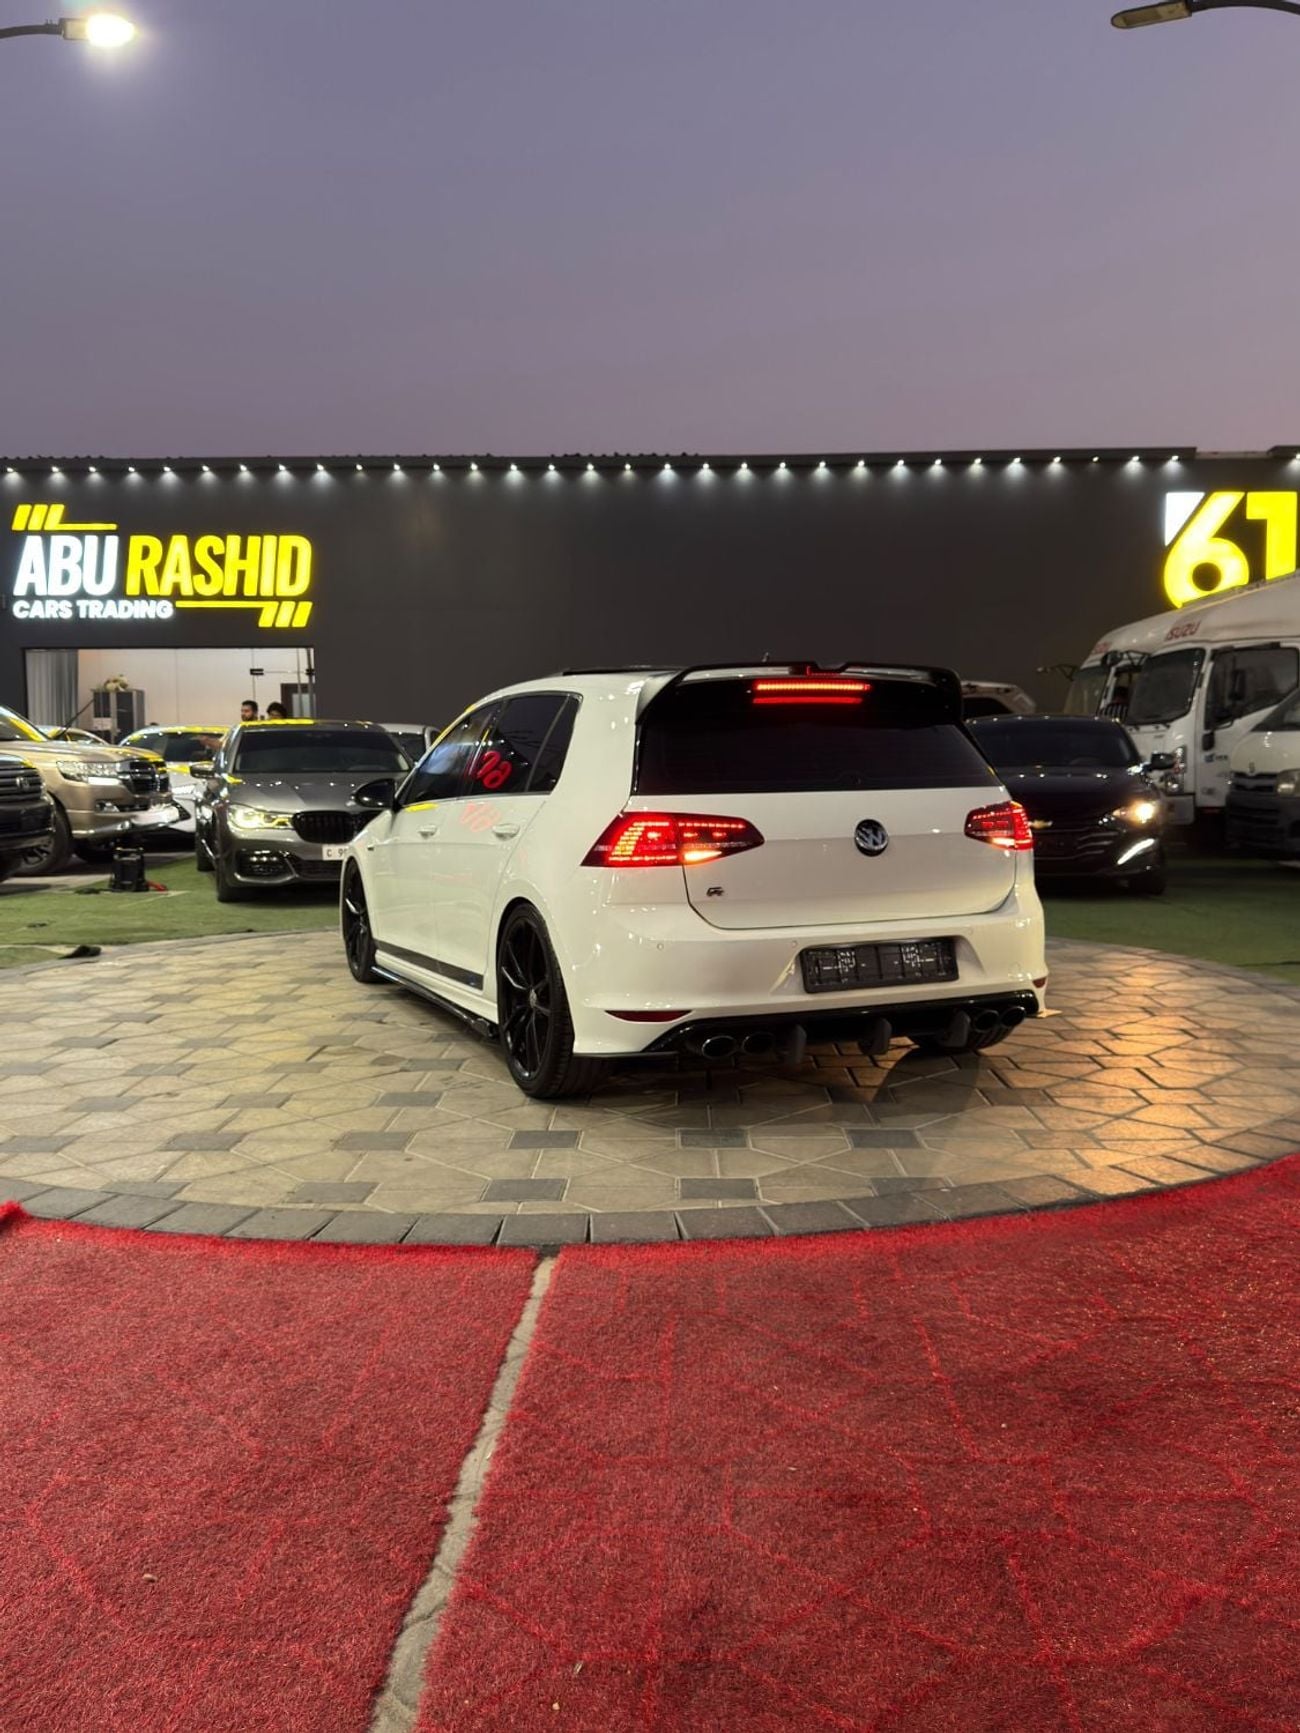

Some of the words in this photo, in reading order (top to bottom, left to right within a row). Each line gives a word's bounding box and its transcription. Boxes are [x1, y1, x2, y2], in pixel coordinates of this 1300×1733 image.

[13, 535, 119, 596] ABU
[126, 535, 312, 597] RASHID
[1164, 491, 1297, 609] 61
[13, 600, 72, 619] CARS
[76, 600, 174, 619] TRADING
[1165, 621, 1201, 640] ISUZU
